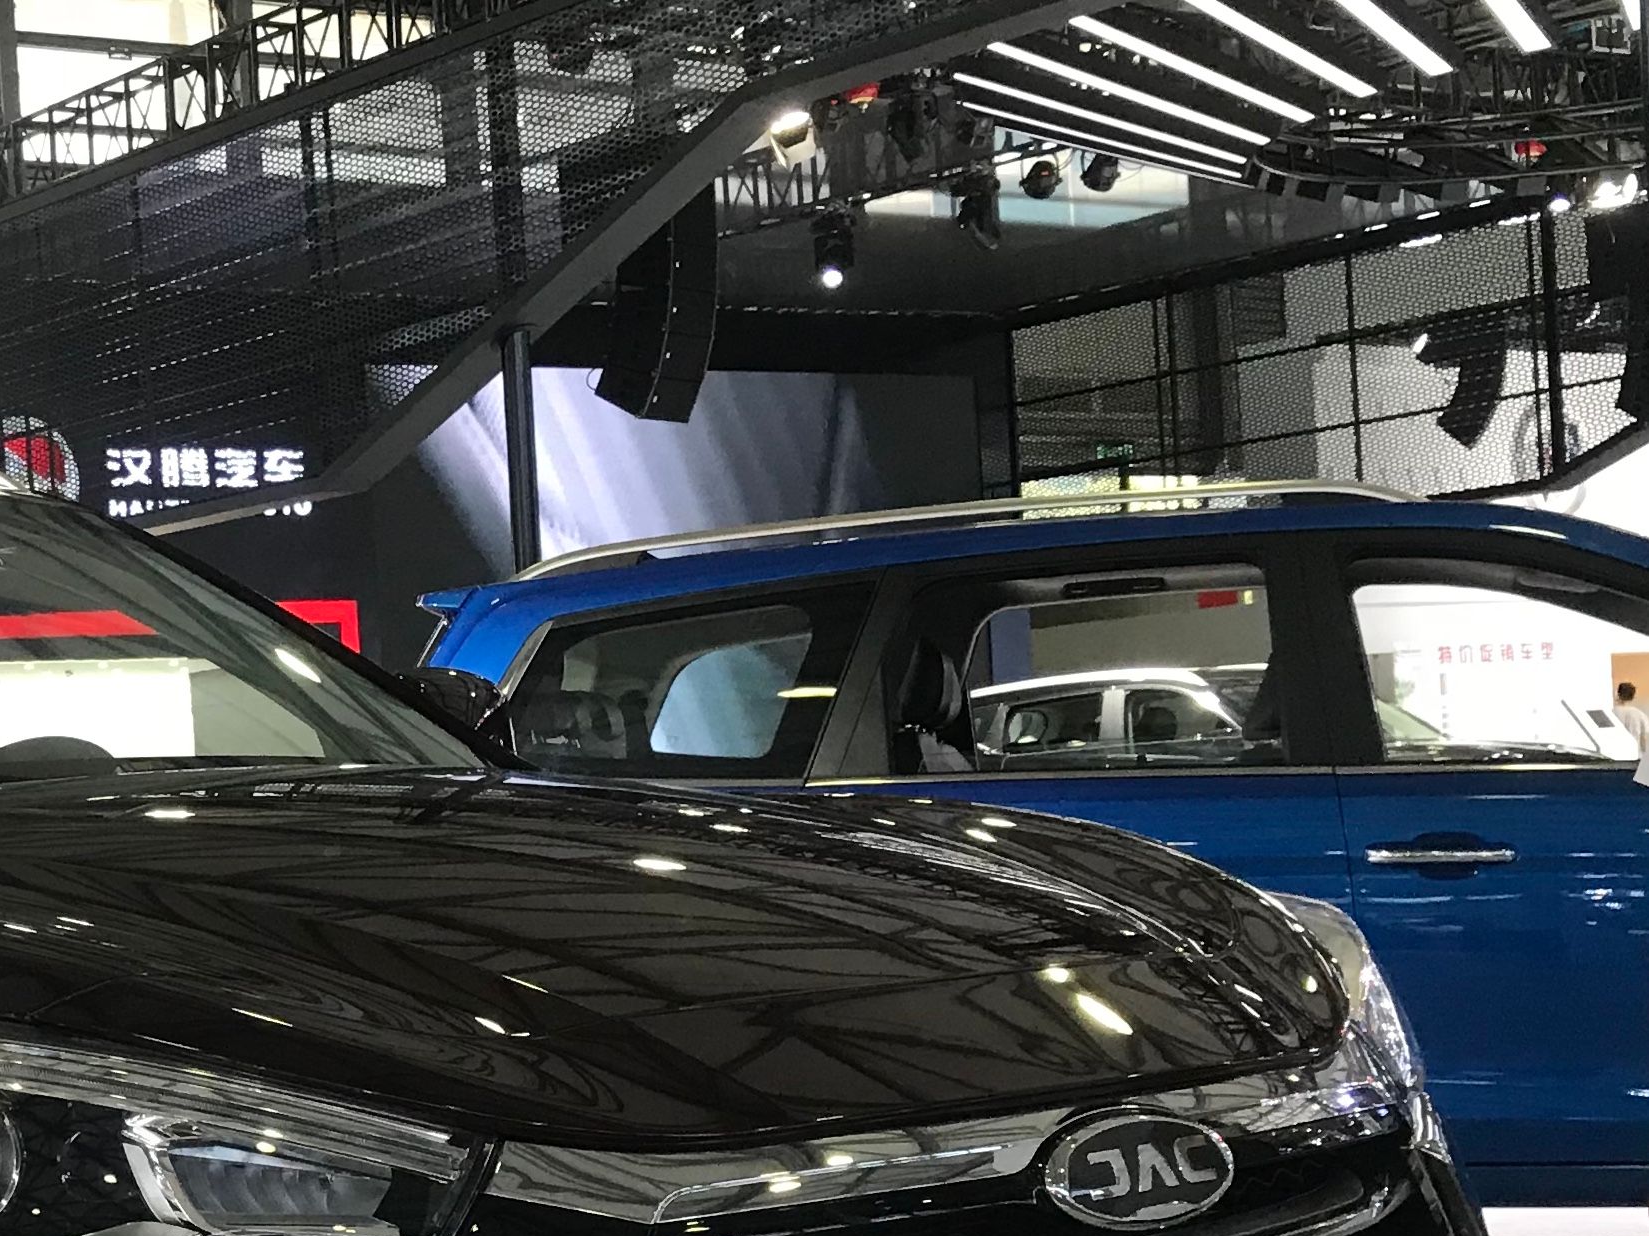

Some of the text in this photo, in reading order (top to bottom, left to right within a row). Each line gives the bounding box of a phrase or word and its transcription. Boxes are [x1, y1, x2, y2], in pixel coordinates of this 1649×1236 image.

[107, 448, 304, 487] 汉腾汽车
[1087, 1134, 1218, 1200] JAC
